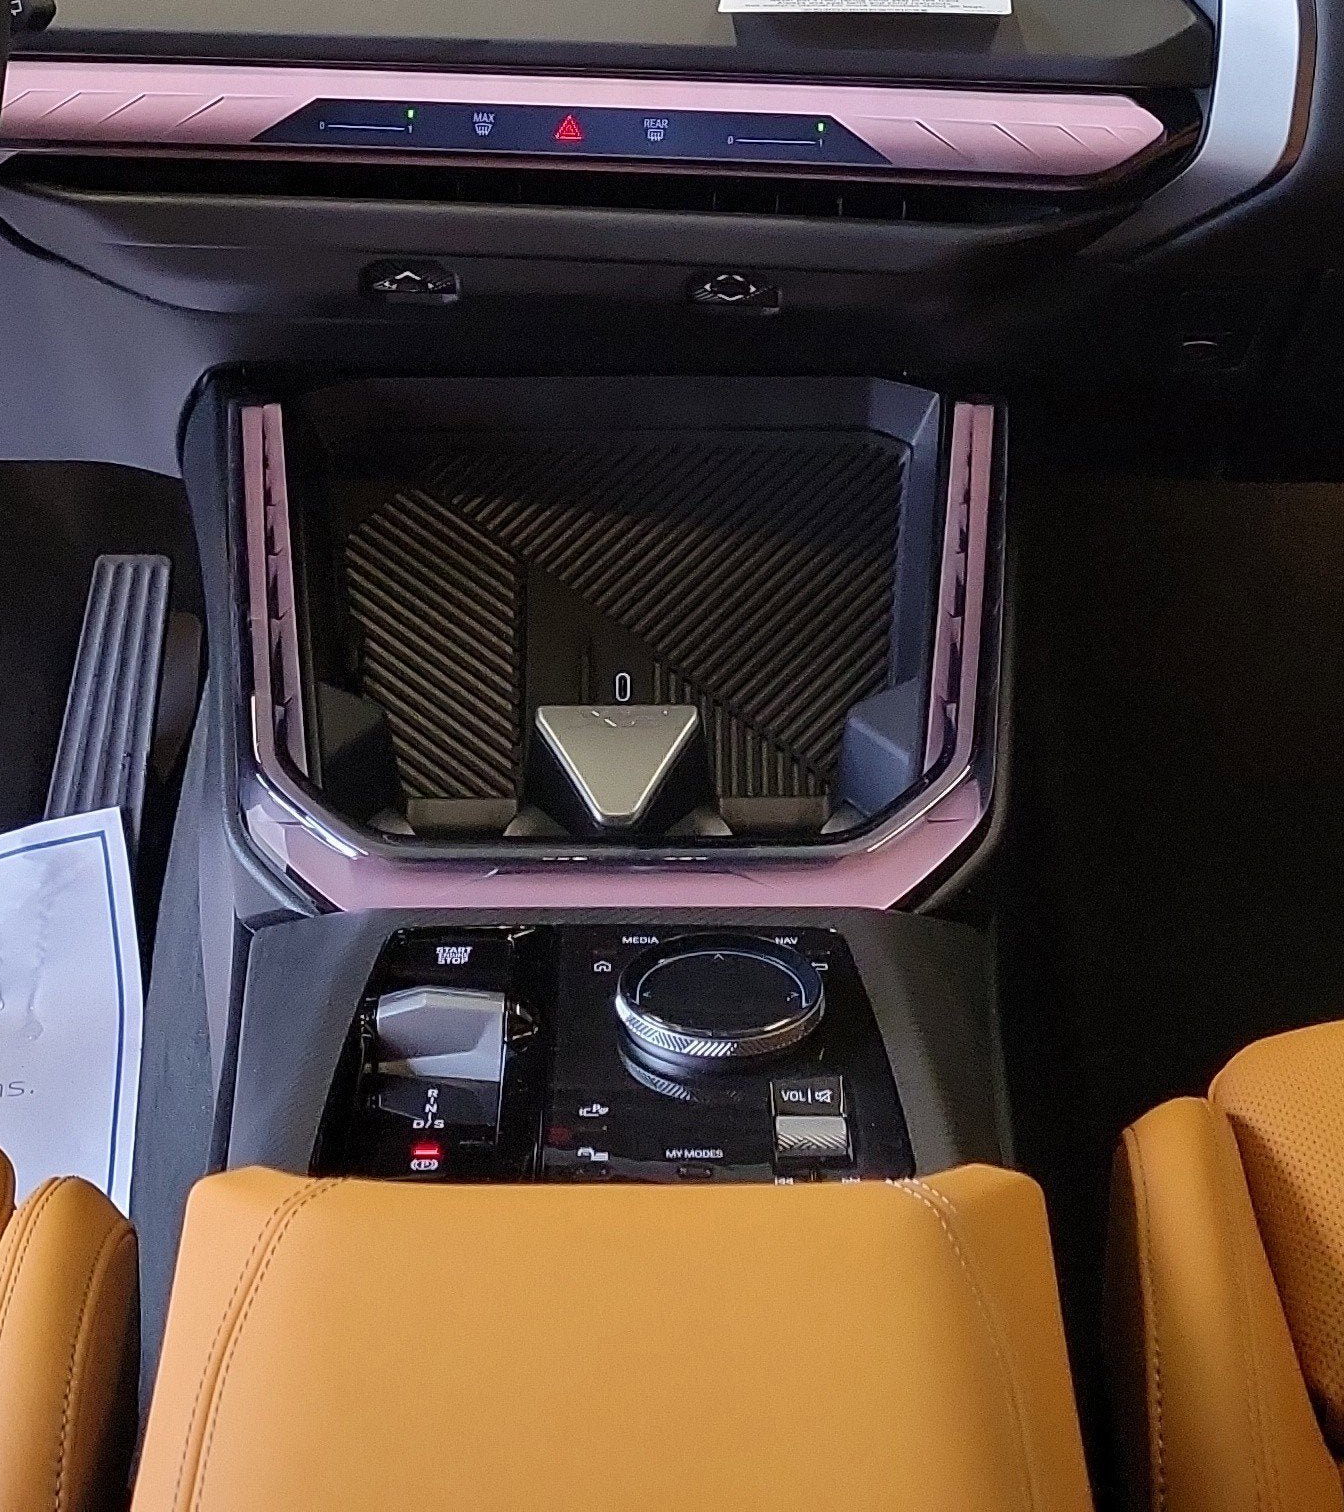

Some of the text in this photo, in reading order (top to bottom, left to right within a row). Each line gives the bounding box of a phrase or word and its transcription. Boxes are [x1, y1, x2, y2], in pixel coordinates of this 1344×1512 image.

[473, 111, 495, 123] MAX
[643, 118, 669, 129] REAR
[622, 936, 659, 945] MEDIA
[775, 936, 798, 946] NAV
[436, 946, 473, 954] START
[437, 957, 469, 965] STOP
[427, 1088, 439, 1098] R
[781, 1089, 806, 1101] VOL
[424, 1103, 438, 1113] N
[665, 1149, 724, 1159] MY MODES
